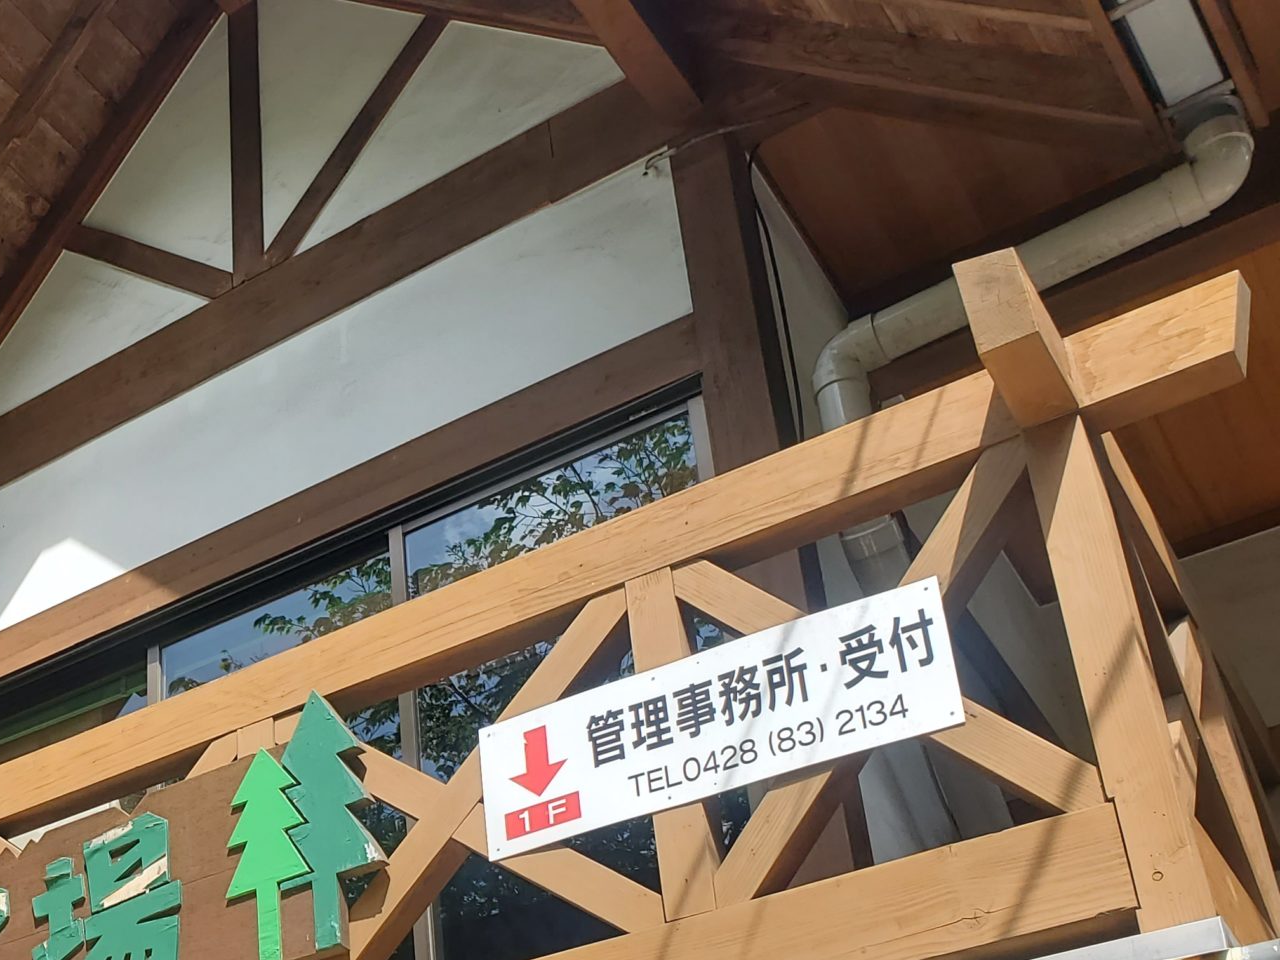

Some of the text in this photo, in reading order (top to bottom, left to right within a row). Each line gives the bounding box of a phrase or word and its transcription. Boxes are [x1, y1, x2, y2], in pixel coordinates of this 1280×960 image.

[586, 608, 934, 768] 管理事務所・受付
[628, 693, 909, 797] TEL0428 (83) 2134
